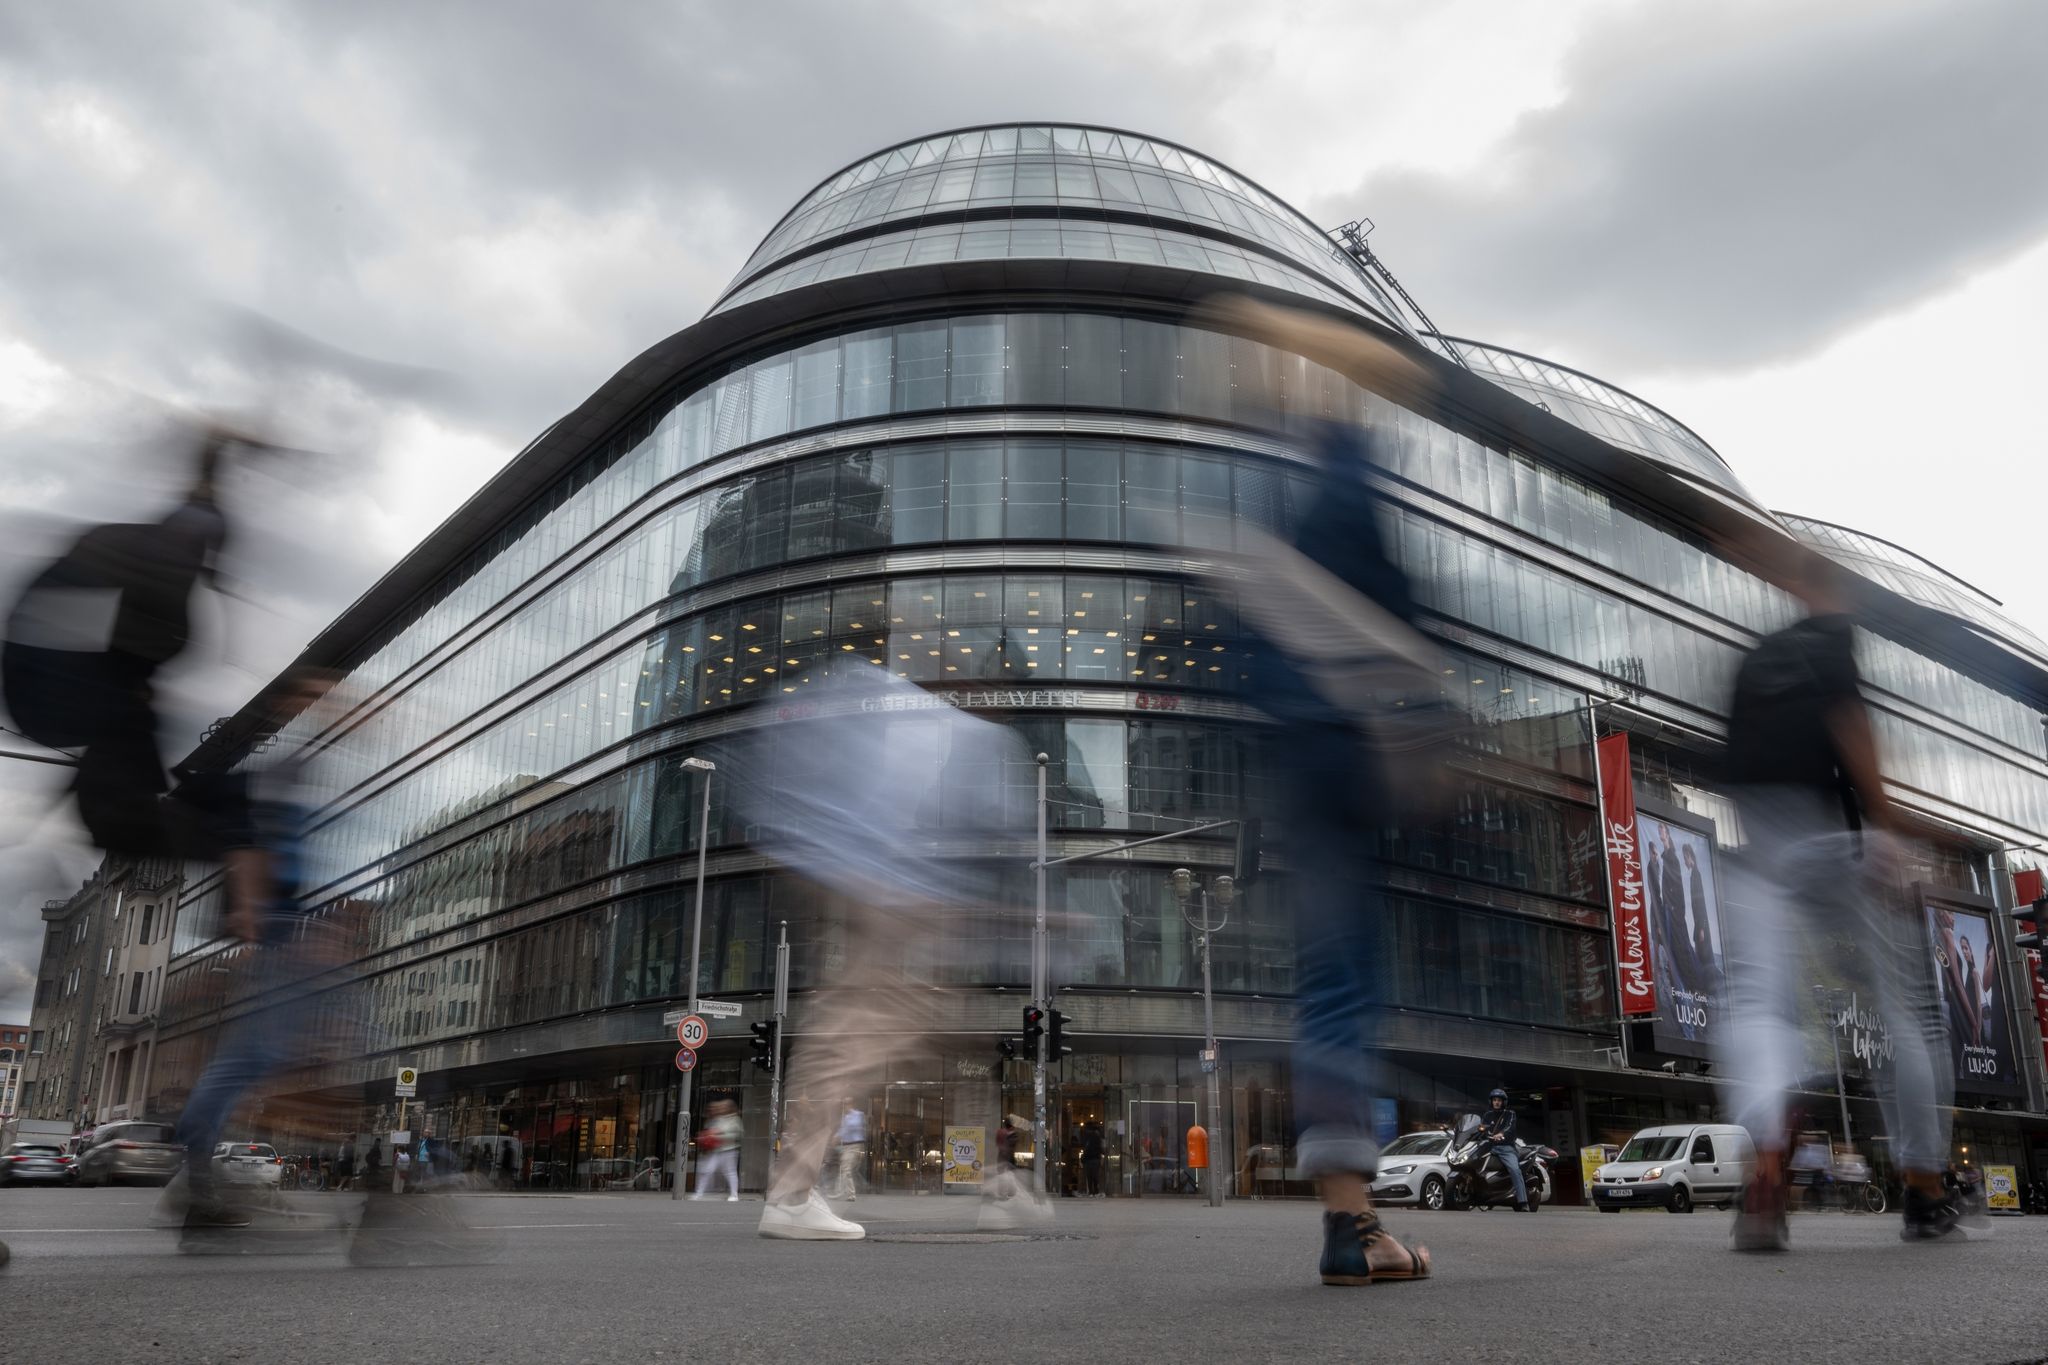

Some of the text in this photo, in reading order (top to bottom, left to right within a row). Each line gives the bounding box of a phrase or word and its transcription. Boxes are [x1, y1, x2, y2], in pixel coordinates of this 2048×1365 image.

[967, 690, 1084, 707] LAFAYETTE
[1607, 816, 1654, 996] Galeries Lafayette
[684, 1024, 701, 1040] 30
